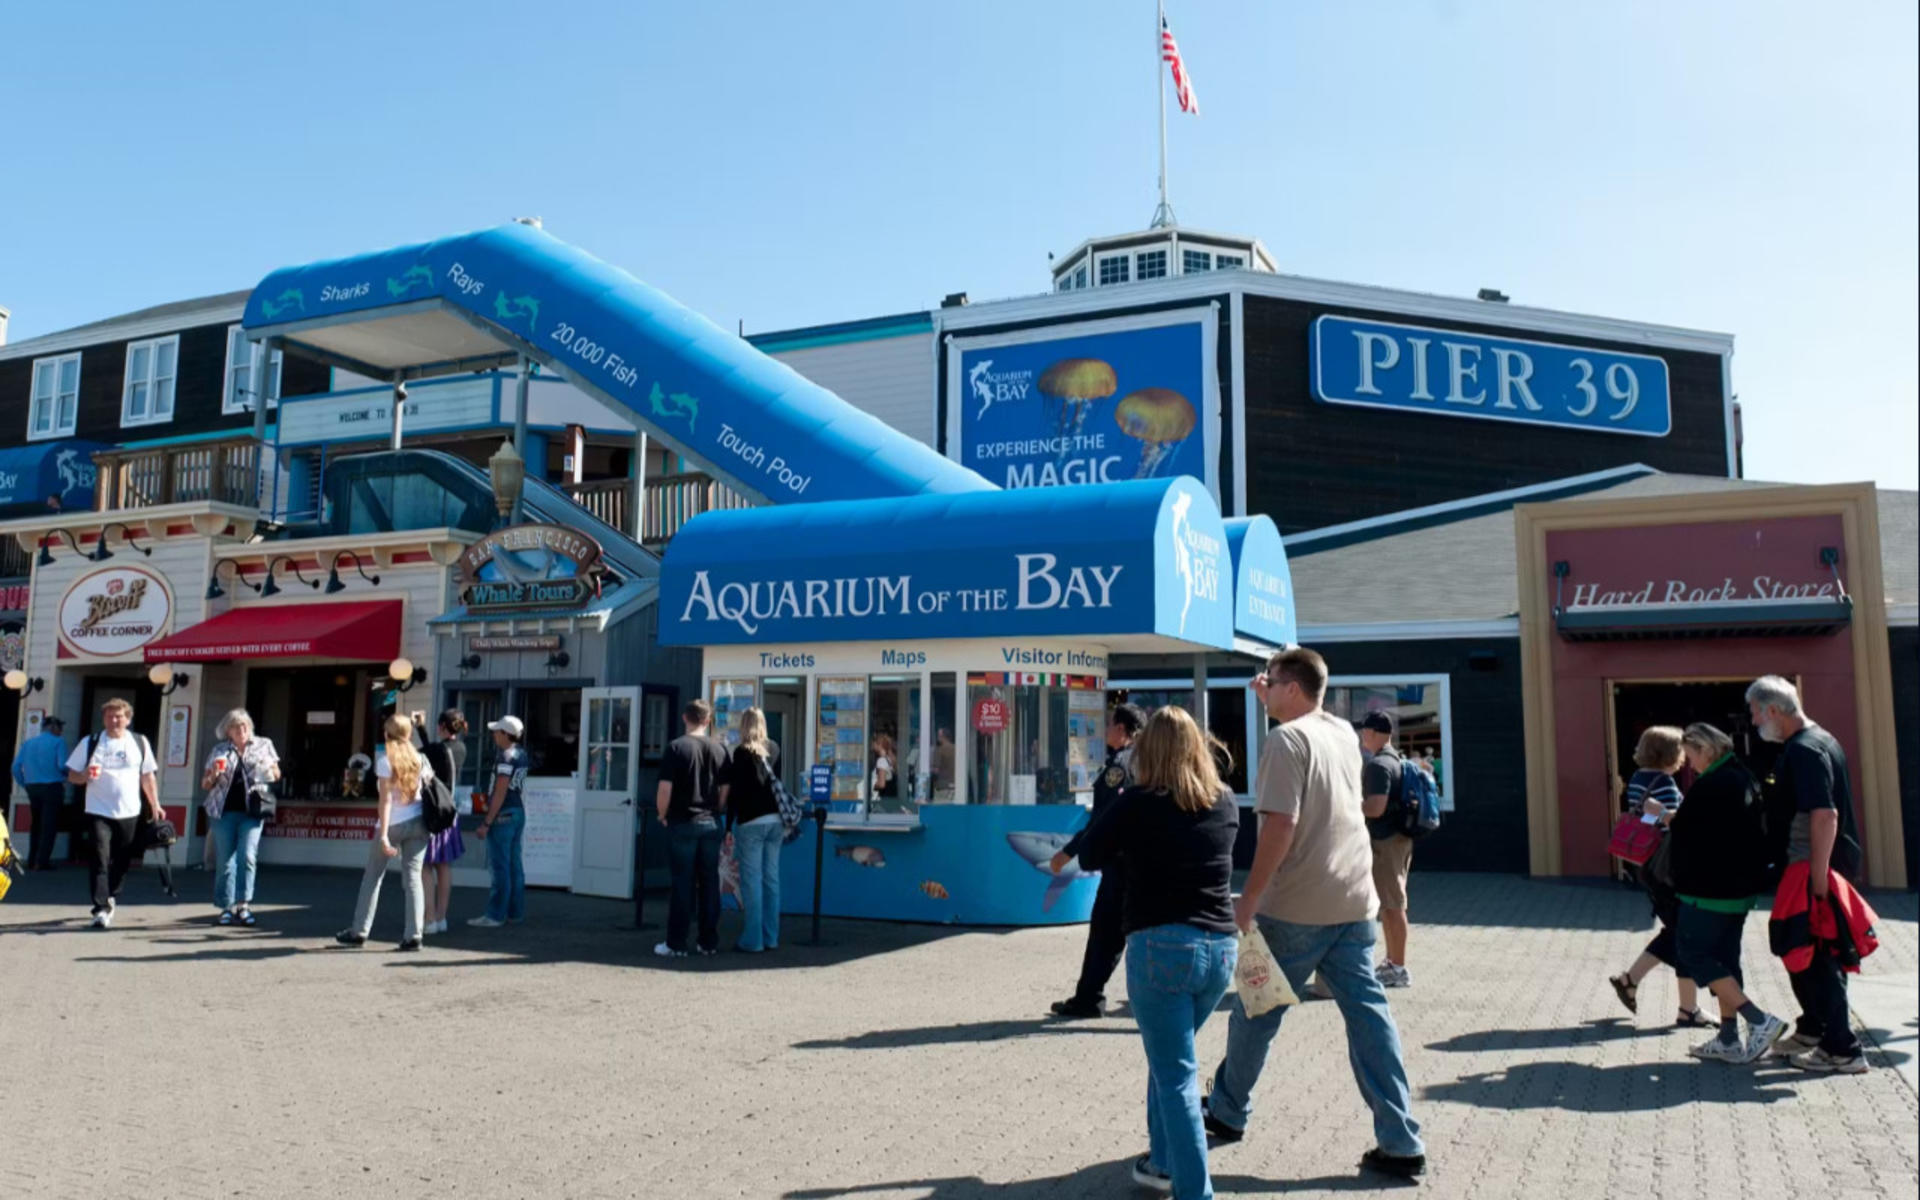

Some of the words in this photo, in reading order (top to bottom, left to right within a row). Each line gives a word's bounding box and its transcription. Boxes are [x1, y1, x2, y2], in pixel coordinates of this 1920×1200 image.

[320, 281, 370, 302] Sharks
[446, 262, 485, 296] Rays
[551, 322, 605, 364] 20,000
[602, 353, 638, 388] Fish
[984, 370, 1032, 383] AQUARIUM
[1352, 330, 1543, 411] PIER
[1567, 358, 1639, 420] 39
[996, 383, 1030, 401] BAY
[339, 409, 369, 423] WELCOME
[376, 408, 386, 419] TO
[716, 424, 765, 468] Touch
[766, 456, 812, 494] Pool
[977, 436, 1072, 459] EXPERIENCE
[1073, 433, 1105, 451] THE
[1006, 456, 1122, 489] MAGIC
[468, 540, 495, 567] SAN
[503, 529, 588, 560] FRANCISCO
[472, 583, 524, 604] Whale
[526, 582, 574, 600] Tours
[680, 570, 912, 635] AQUARIUM
[917, 590, 951, 613] OF
[956, 588, 1008, 611] THE
[1014, 552, 1124, 610] BAY
[1194, 557, 1218, 602] BAY
[1571, 581, 1655, 607] Hard
[1664, 577, 1737, 603] Rock
[1748, 575, 1834, 599] Store
[71, 626, 108, 638] COFFEE
[111, 624, 152, 636] CORNER
[284, 641, 310, 652] COFFEE
[759, 651, 816, 668] Tickets
[881, 648, 926, 668] Maps
[1002, 647, 1063, 664] Visitor
